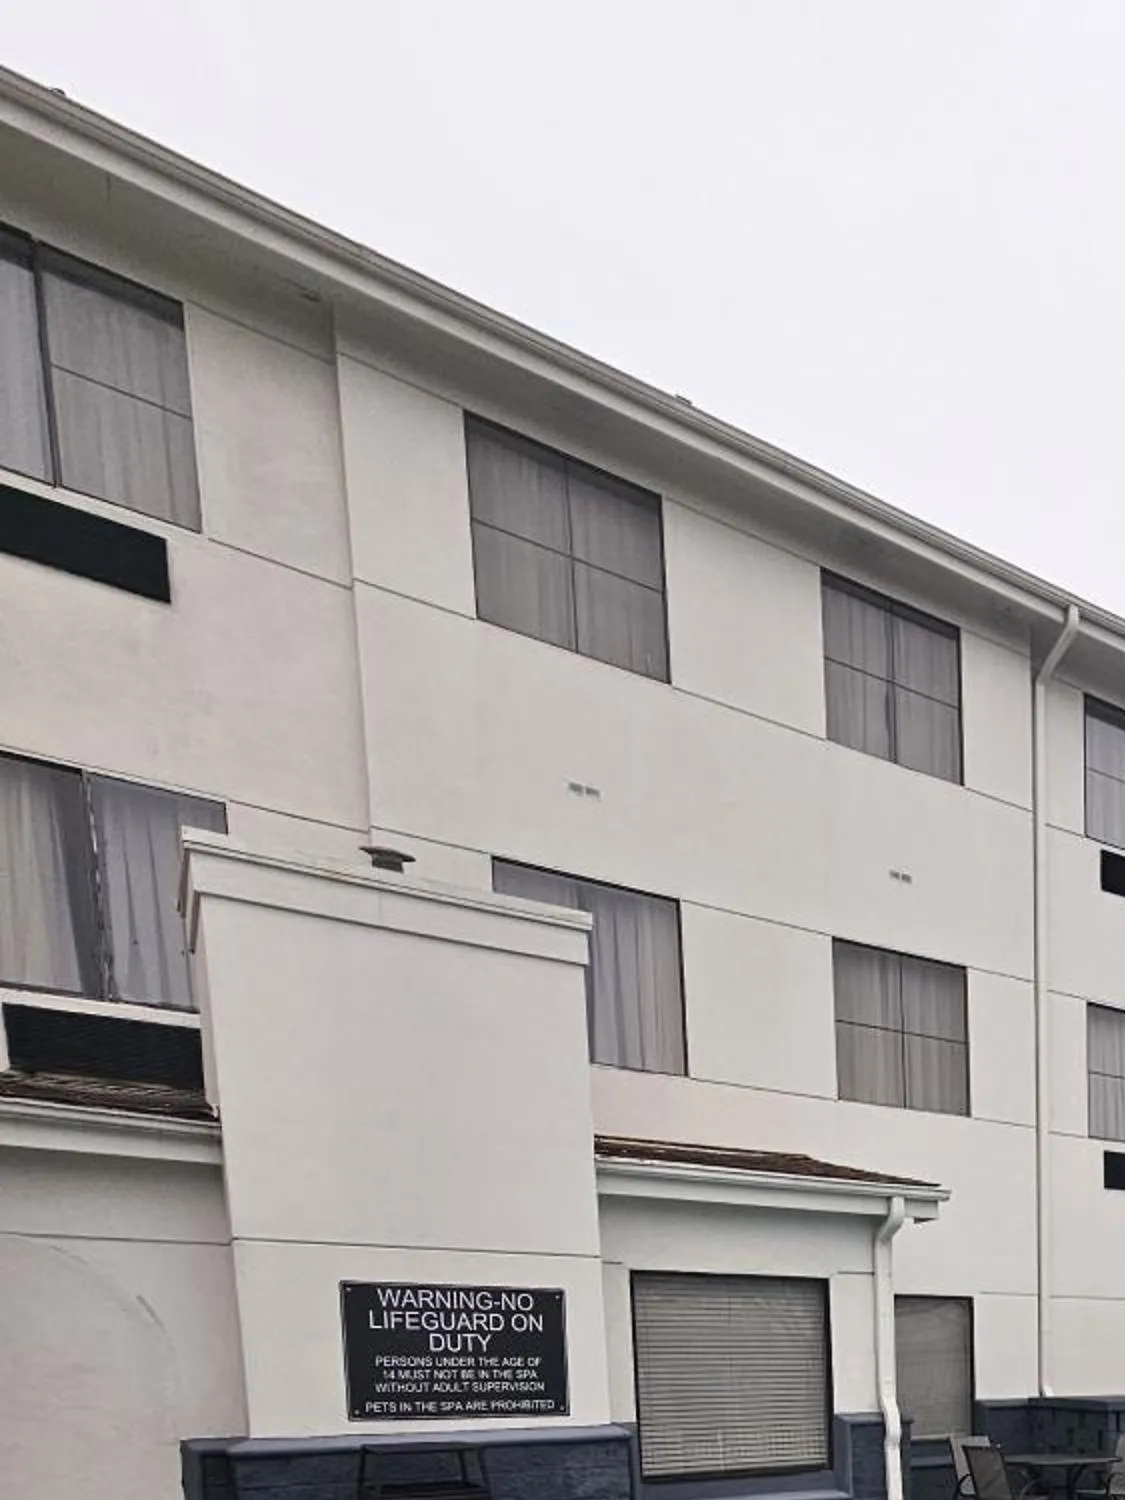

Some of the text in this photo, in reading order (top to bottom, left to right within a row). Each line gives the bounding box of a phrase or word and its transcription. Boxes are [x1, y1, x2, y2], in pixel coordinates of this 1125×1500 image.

[377, 1288, 534, 1311] WARNING-NO
[368, 1310, 544, 1332] LIFEGUARD ON
[429, 1333, 492, 1352] DUTY
[375, 1355, 542, 1367] PERSONS UNDER THE AGE OF
[398, 1369, 430, 1379] MUST
[433, 1369, 458, 1379] NOT
[461, 1369, 475, 1379] BE
[478, 1369, 489, 1379] IN
[493, 1369, 513, 1379] THE
[515, 1369, 538, 1379] SPA
[375, 1381, 545, 1392] WITHOUT ADULT SUPERVISION
[365, 1399, 555, 1413] PETS IN THE SPA ARE PROHIBITED
